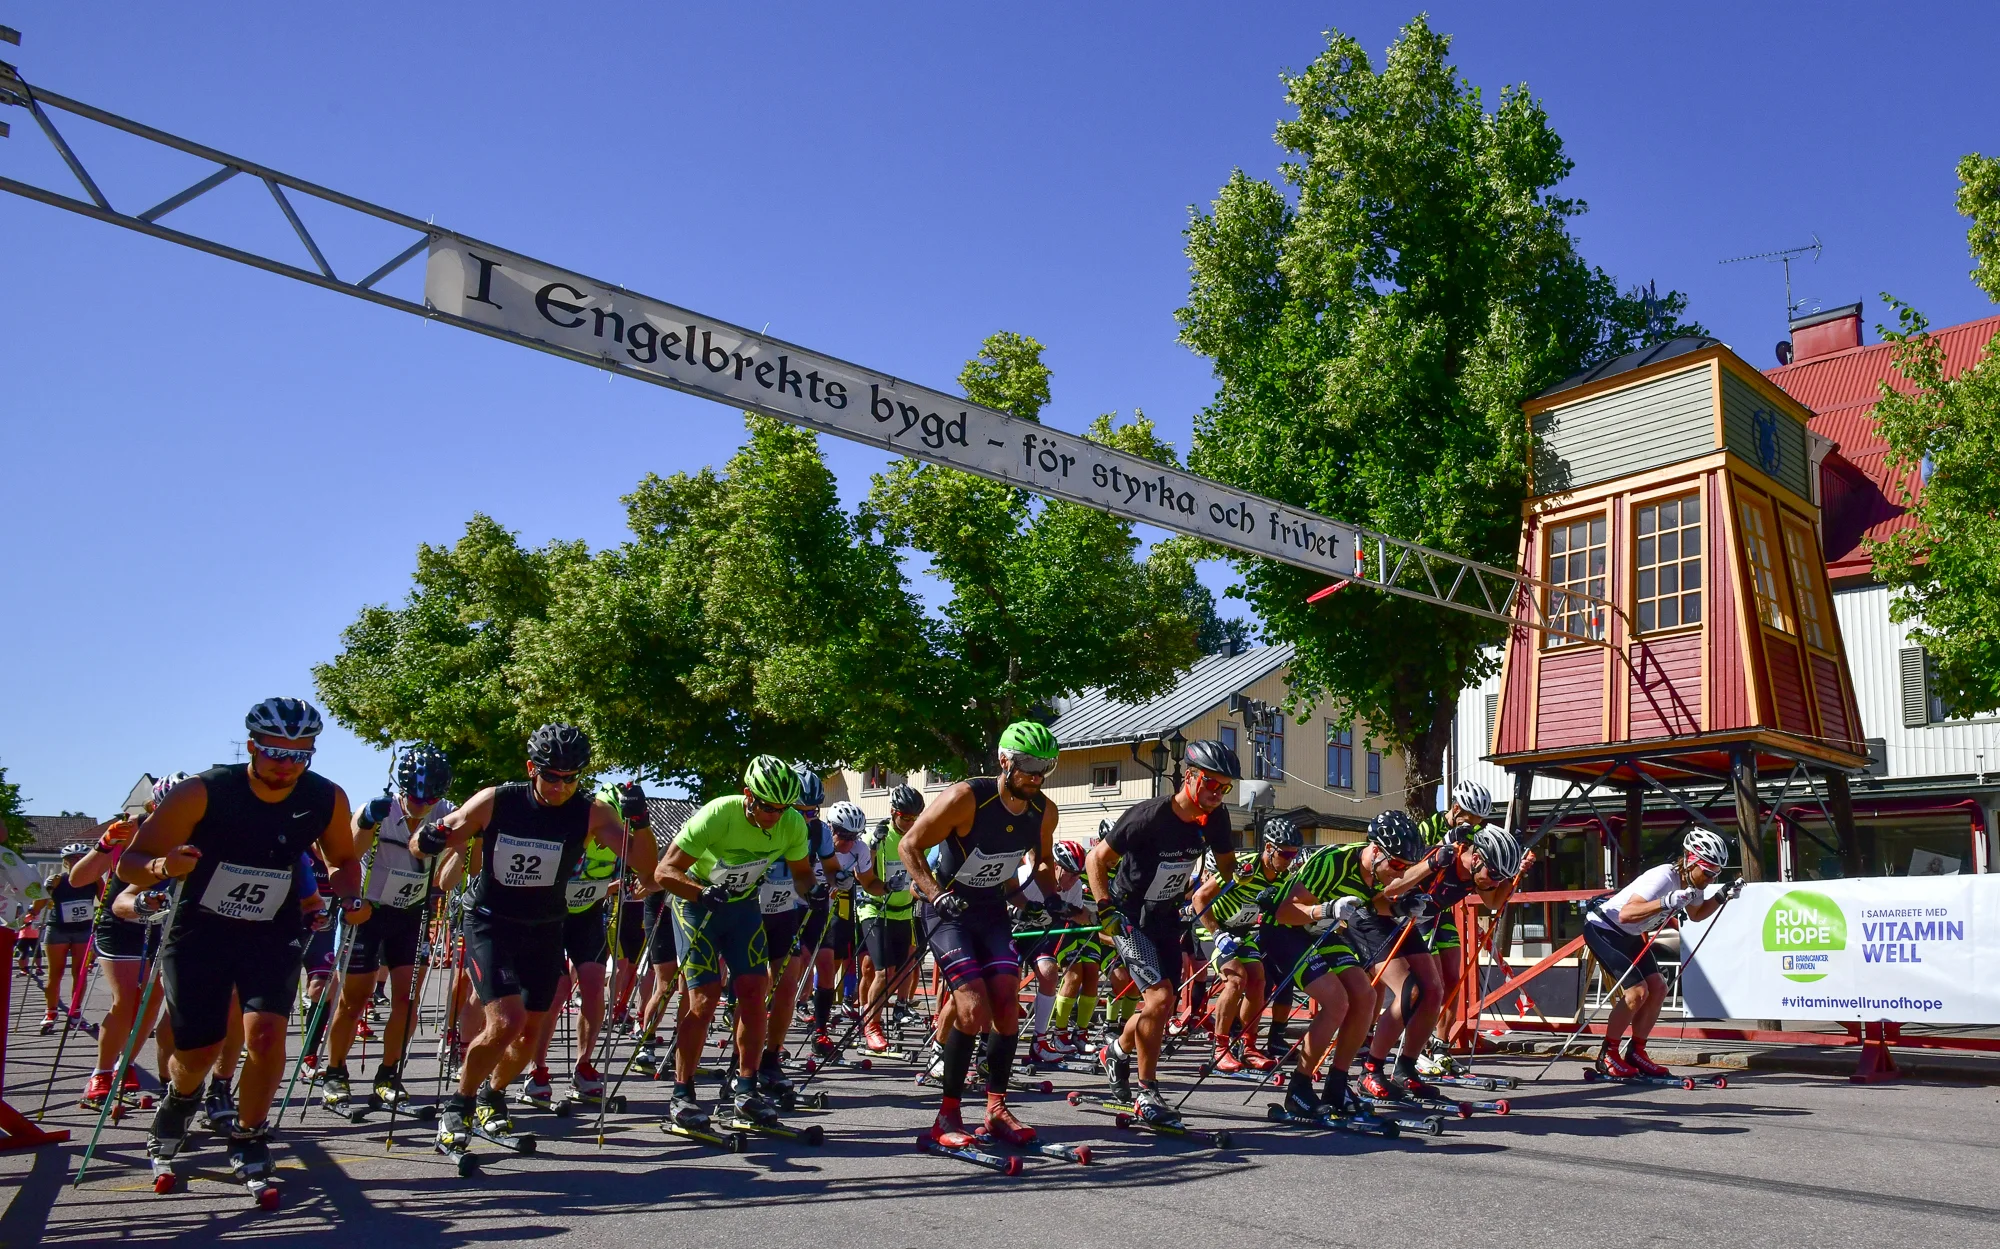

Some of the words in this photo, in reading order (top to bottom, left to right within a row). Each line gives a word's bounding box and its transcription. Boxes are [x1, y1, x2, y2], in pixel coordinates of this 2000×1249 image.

[466, 252, 502, 310] I
[535, 283, 848, 410] Engelbrekts
[870, 384, 969, 449] bygd
[1022, 433, 1076, 478] för
[1092, 463, 1196, 516] styrka
[1208, 501, 1255, 534] och
[1269, 512, 1340, 559] frihet
[499, 836, 561, 852] ENGELBREKTSRULLEN
[510, 853, 542, 875] 32
[975, 862, 1004, 878] 23
[505, 872, 542, 881] VITAMIN
[505, 878, 527, 886] WELL
[725, 871, 750, 884] 51
[1163, 872, 1187, 890] 29
[227, 882, 270, 905] 45
[398, 883, 425, 898] 49
[573, 885, 597, 899] 40
[770, 890, 792, 904] 52
[219, 900, 265, 914] VITAMIN
[568, 897, 595, 905] VITAMIN
[71, 905, 88, 916] 95
[217, 906, 243, 918] WELL
[1240, 911, 1257, 923] 37
[1775, 908, 1818, 927] RUN
[1861, 910, 1865, 919] I
[1866, 908, 1923, 918] SAMARBETE
[1925, 908, 1948, 917] MED
[1775, 926, 1831, 945] HOPE
[1862, 921, 1964, 942] VITAMIN
[1795, 954, 1829, 963] BARNCANCER
[1862, 943, 1922, 963] WELL
[1795, 962, 1816, 970] FONDEN
[1781, 995, 1943, 1012] #vitaminwellrunofhope
[1291, 1094, 1311, 1111] ATOMIC
